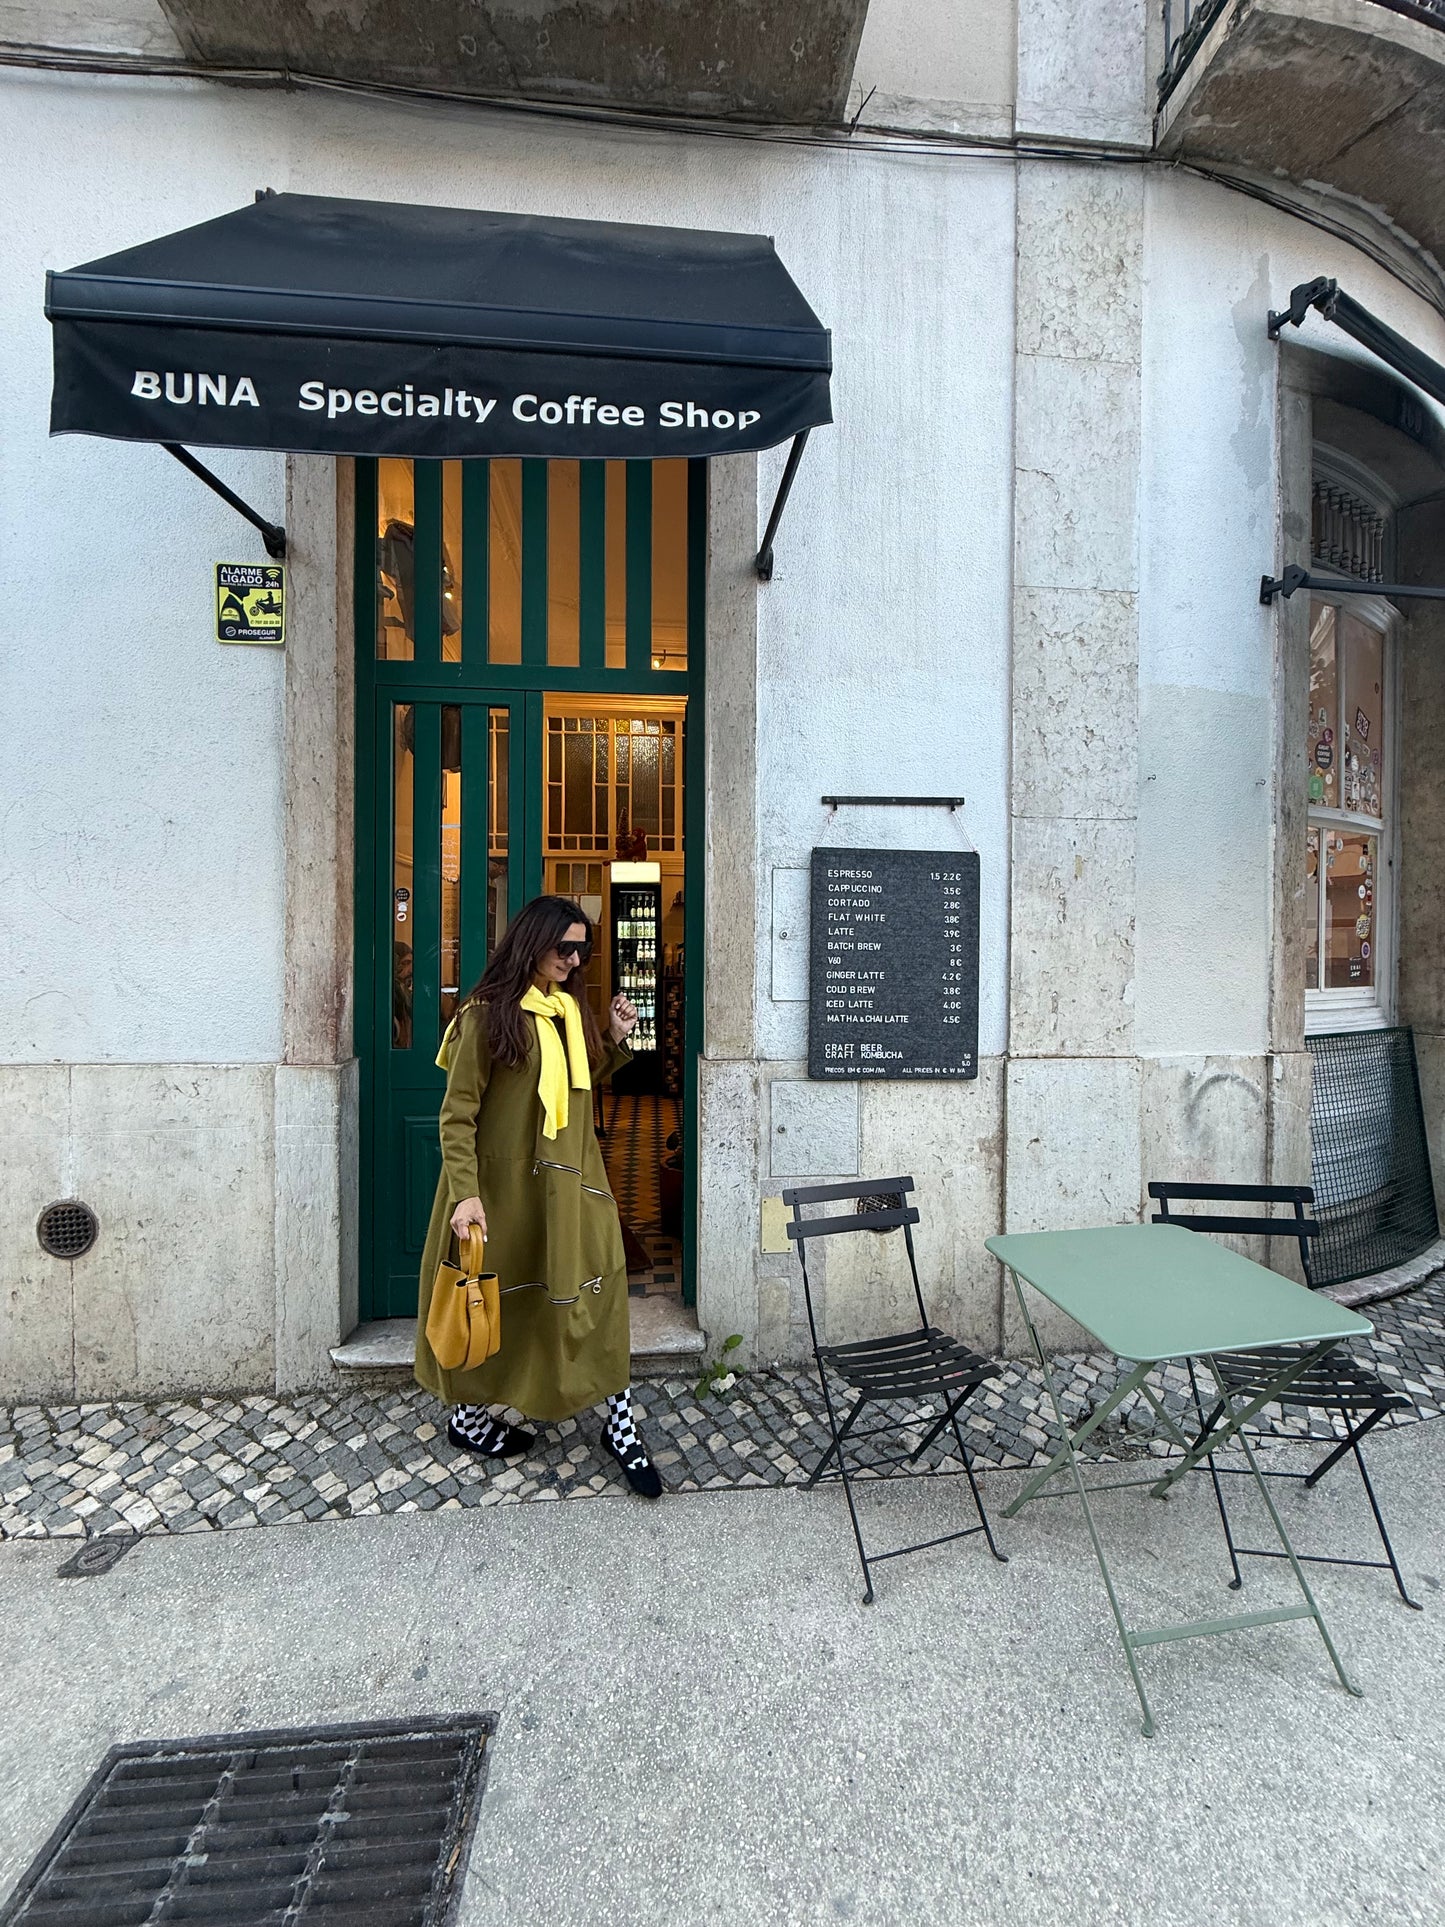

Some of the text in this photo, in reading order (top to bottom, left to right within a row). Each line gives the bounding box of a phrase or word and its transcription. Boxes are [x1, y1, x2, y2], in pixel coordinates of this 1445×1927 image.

[130, 370, 762, 432] BUNA Specialty Coffee Shop
[221, 567, 263, 576] ALARME
[221, 574, 263, 584] LIGADO
[828, 870, 872, 879] ESPRESSO
[943, 873, 961, 881] 2.2€
[828, 884, 882, 893] CAPPUCCINO
[828, 899, 960, 910] CORTADO 2.8€
[829, 913, 850, 921] FLAT
[855, 914, 886, 922] WHITE
[828, 928, 854, 936] LATTE
[828, 942, 962, 952] BATCH BREW 3€
[950, 959, 962, 967] 8€
[826, 971, 962, 981] GINGER LATTE 4.2€
[826, 986, 847, 994] COLD
[850, 986, 876, 994] BREW
[826, 1000, 844, 1008] ICED
[848, 1000, 873, 1008] LATTE
[827, 1015, 858, 1023] MATHA
[865, 1015, 883, 1023] CHAI
[884, 1015, 909, 1023] LATTE
[825, 1044, 883, 1052] CRAFT BEER
[825, 1051, 855, 1059] CRAFT
[861, 1051, 903, 1059] KOMBUCHA
